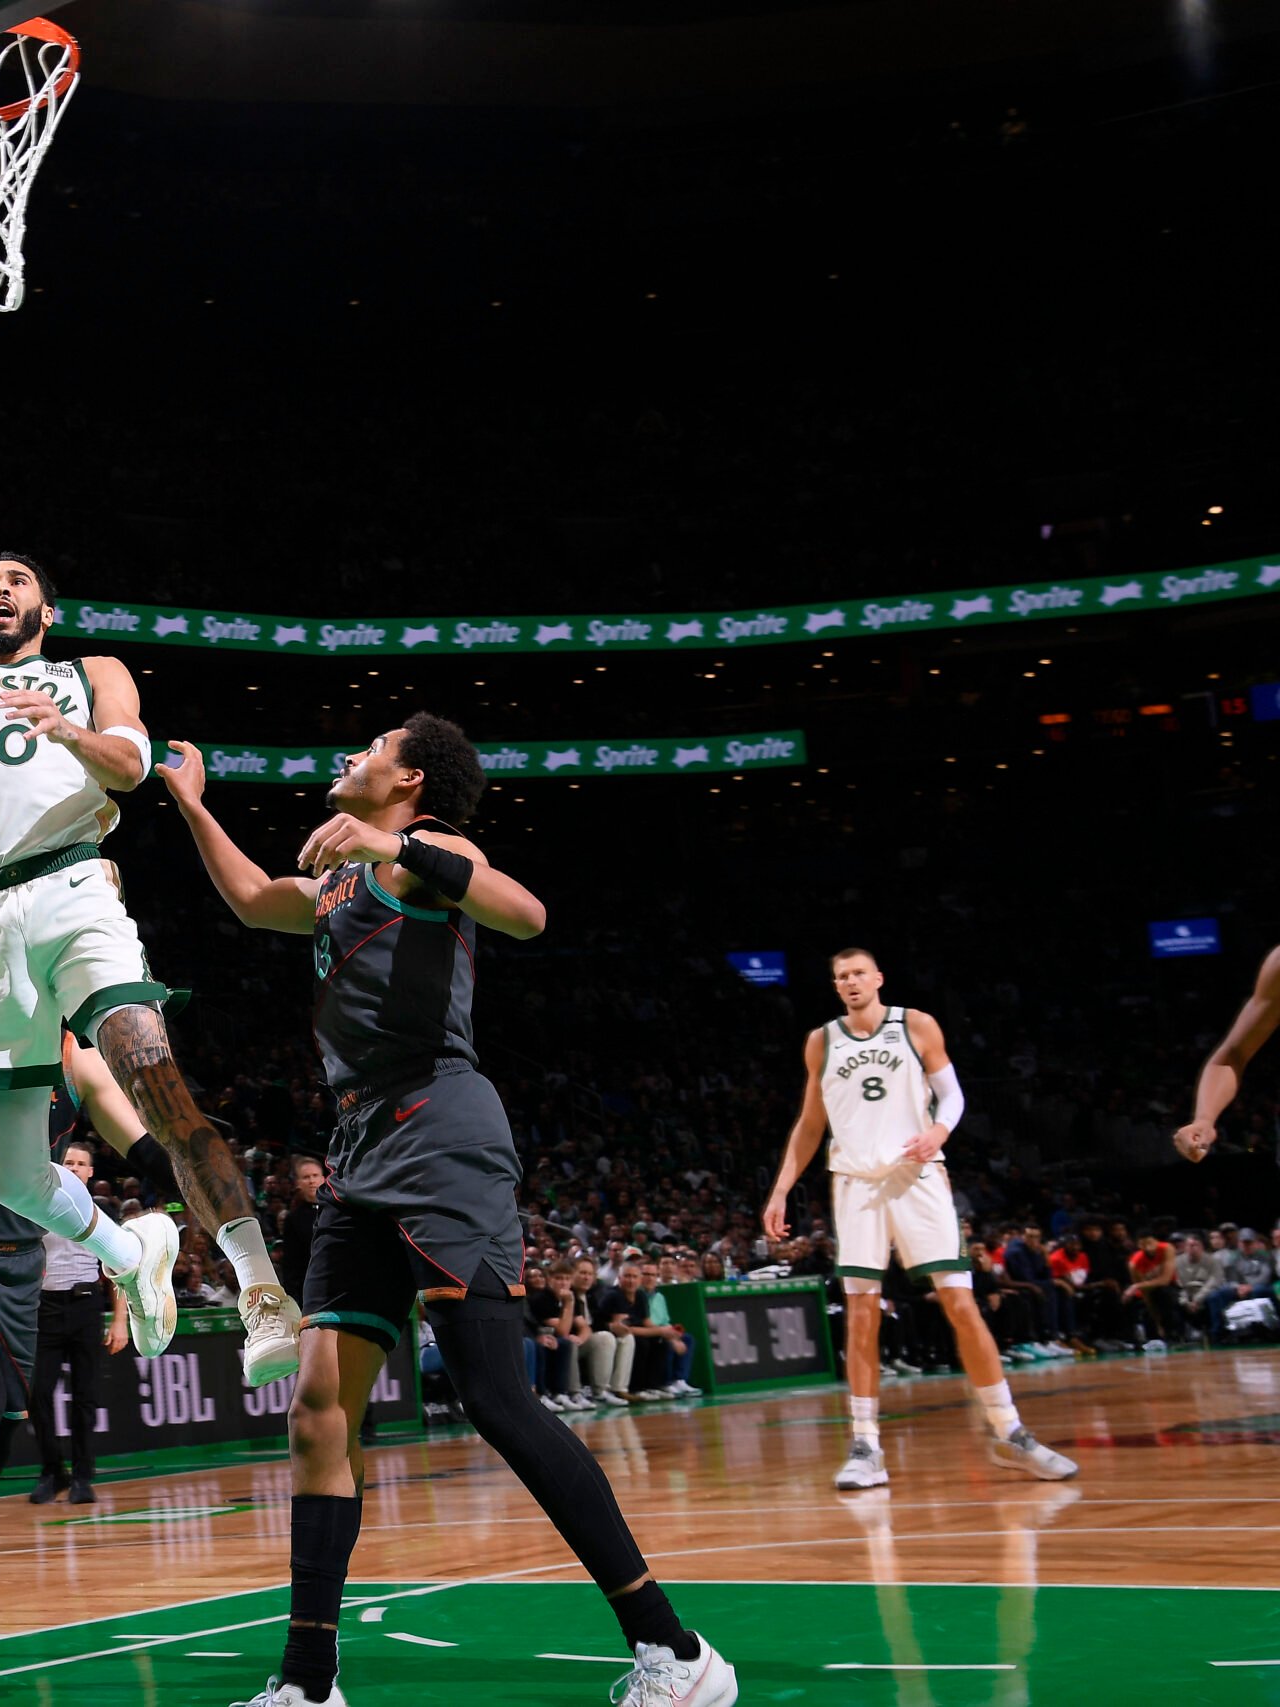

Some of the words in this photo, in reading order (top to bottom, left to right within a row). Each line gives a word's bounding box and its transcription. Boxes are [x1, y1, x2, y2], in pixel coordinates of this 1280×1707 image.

[1158, 569, 1238, 602] Sprite
[860, 600, 933, 630] Sprite
[1007, 586, 1083, 616] Sprite
[76, 606, 141, 634] Sprite
[200, 615, 262, 644] Sprite
[585, 619, 653, 646] Sprite
[716, 613, 788, 643] Sprite
[320, 623, 386, 653] Sprite
[452, 621, 521, 649] Sprite
[210, 750, 269, 777] Sprite
[478, 747, 529, 770] prite
[593, 744, 659, 772] Sprite
[722, 737, 796, 766] Sprite
[836, 1048, 904, 1080] BOSTON
[861, 1076, 888, 1102] 8
[134, 1353, 216, 1427] JBL
